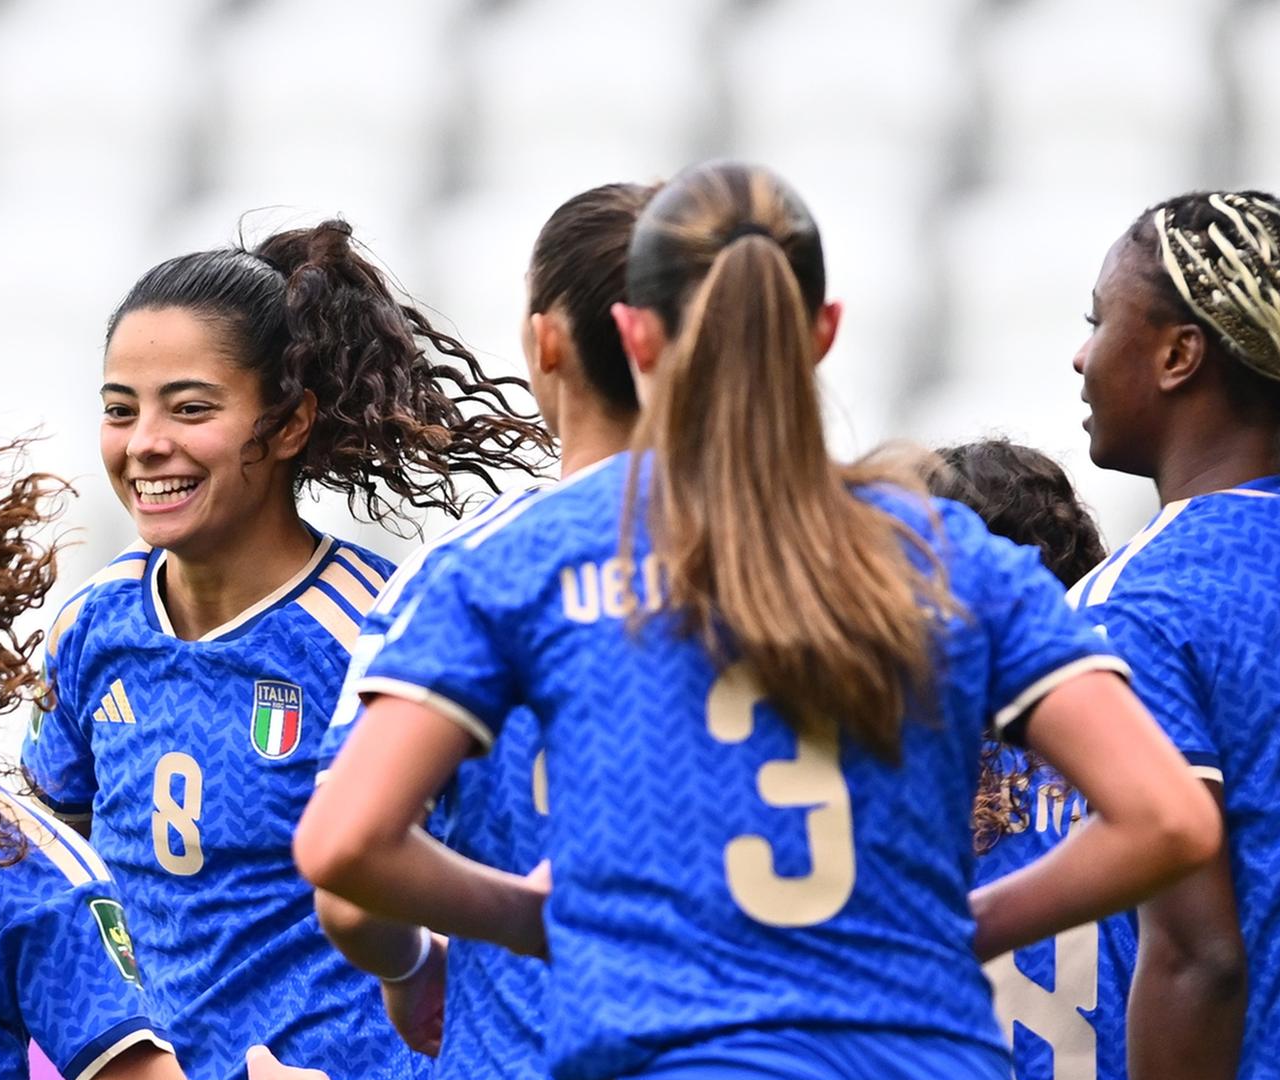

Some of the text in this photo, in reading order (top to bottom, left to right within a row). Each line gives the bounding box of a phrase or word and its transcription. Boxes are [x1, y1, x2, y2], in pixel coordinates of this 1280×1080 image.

[258, 684, 299, 705] ITALIA
[151, 751, 204, 877] 8
[705, 660, 857, 928] 3
